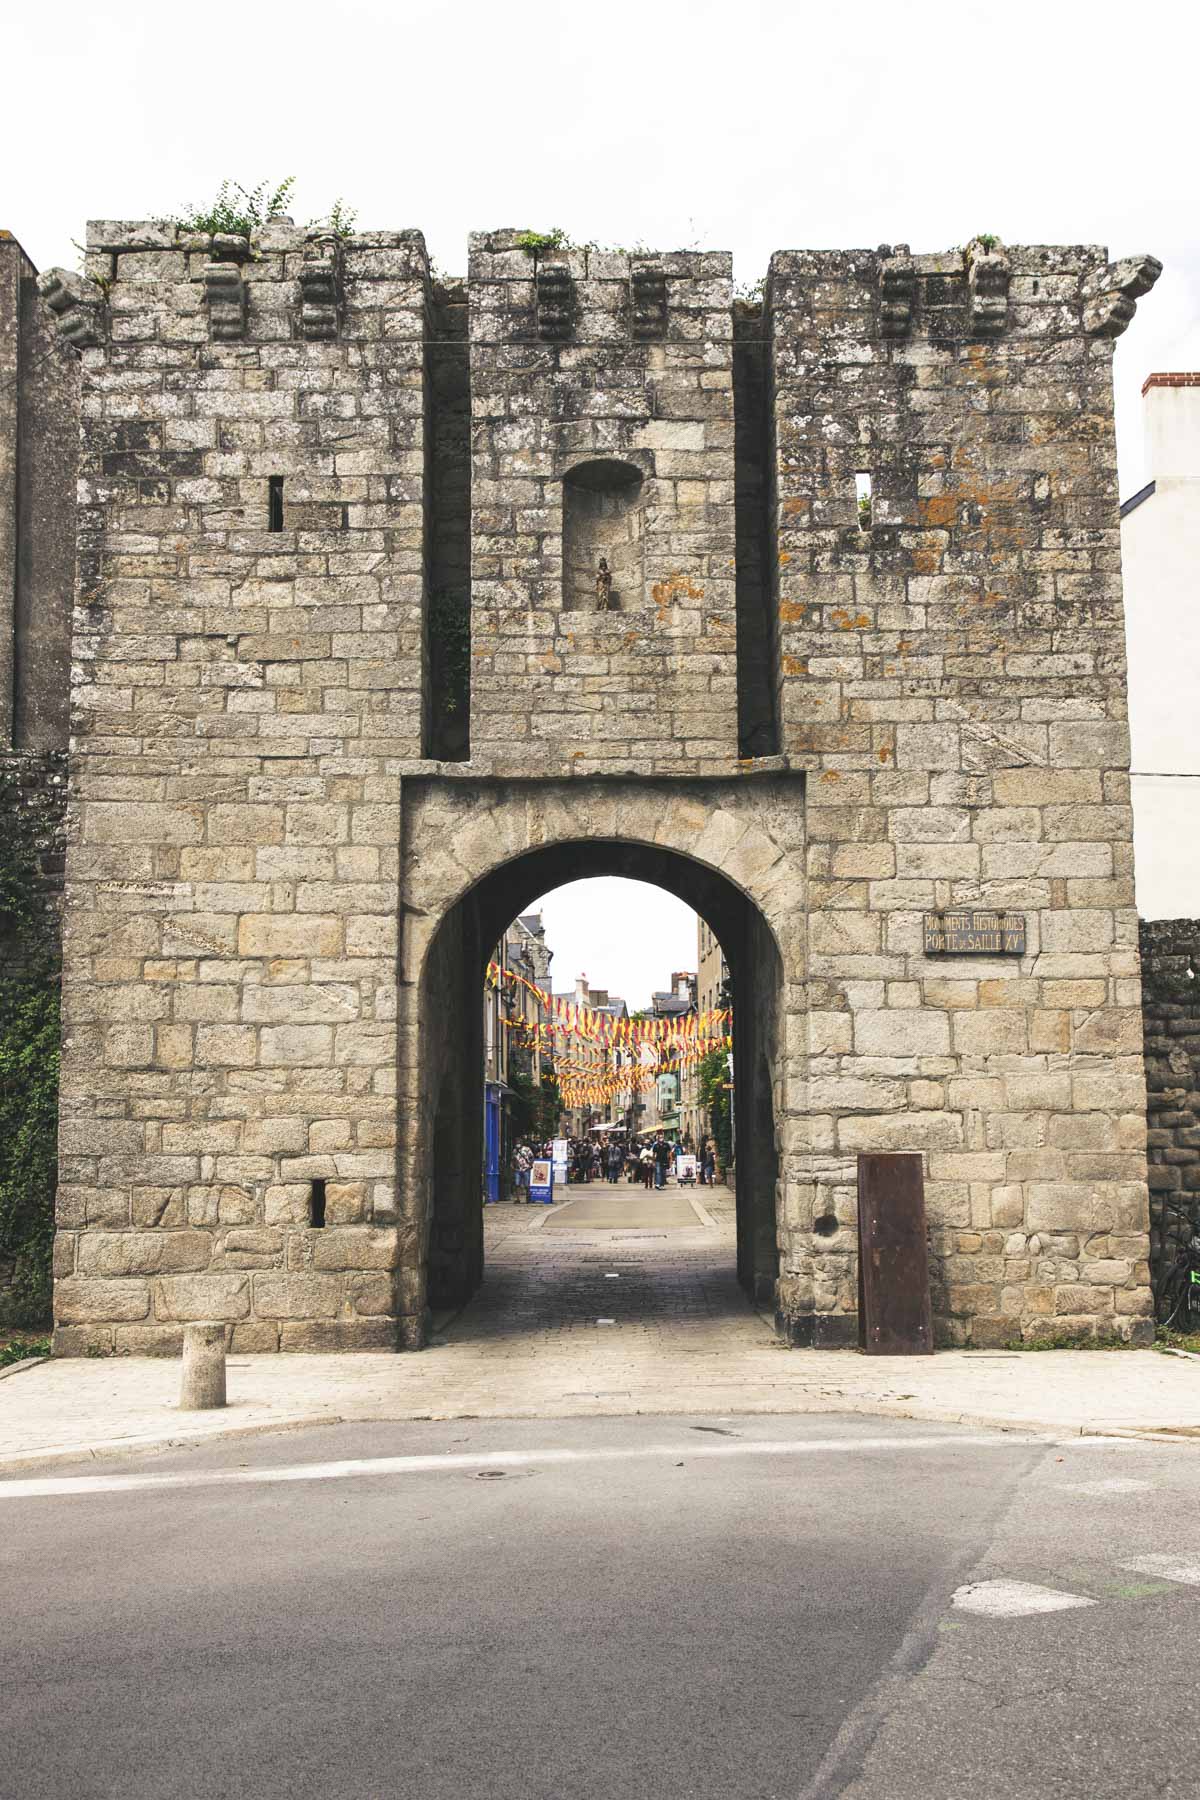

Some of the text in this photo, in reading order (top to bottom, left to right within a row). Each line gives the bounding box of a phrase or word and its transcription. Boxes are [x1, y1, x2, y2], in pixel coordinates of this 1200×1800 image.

[973, 915, 1024, 931] HISTORIQUES
[925, 933, 958, 950] PORTE
[967, 932, 1002, 951] SAILLÉ
